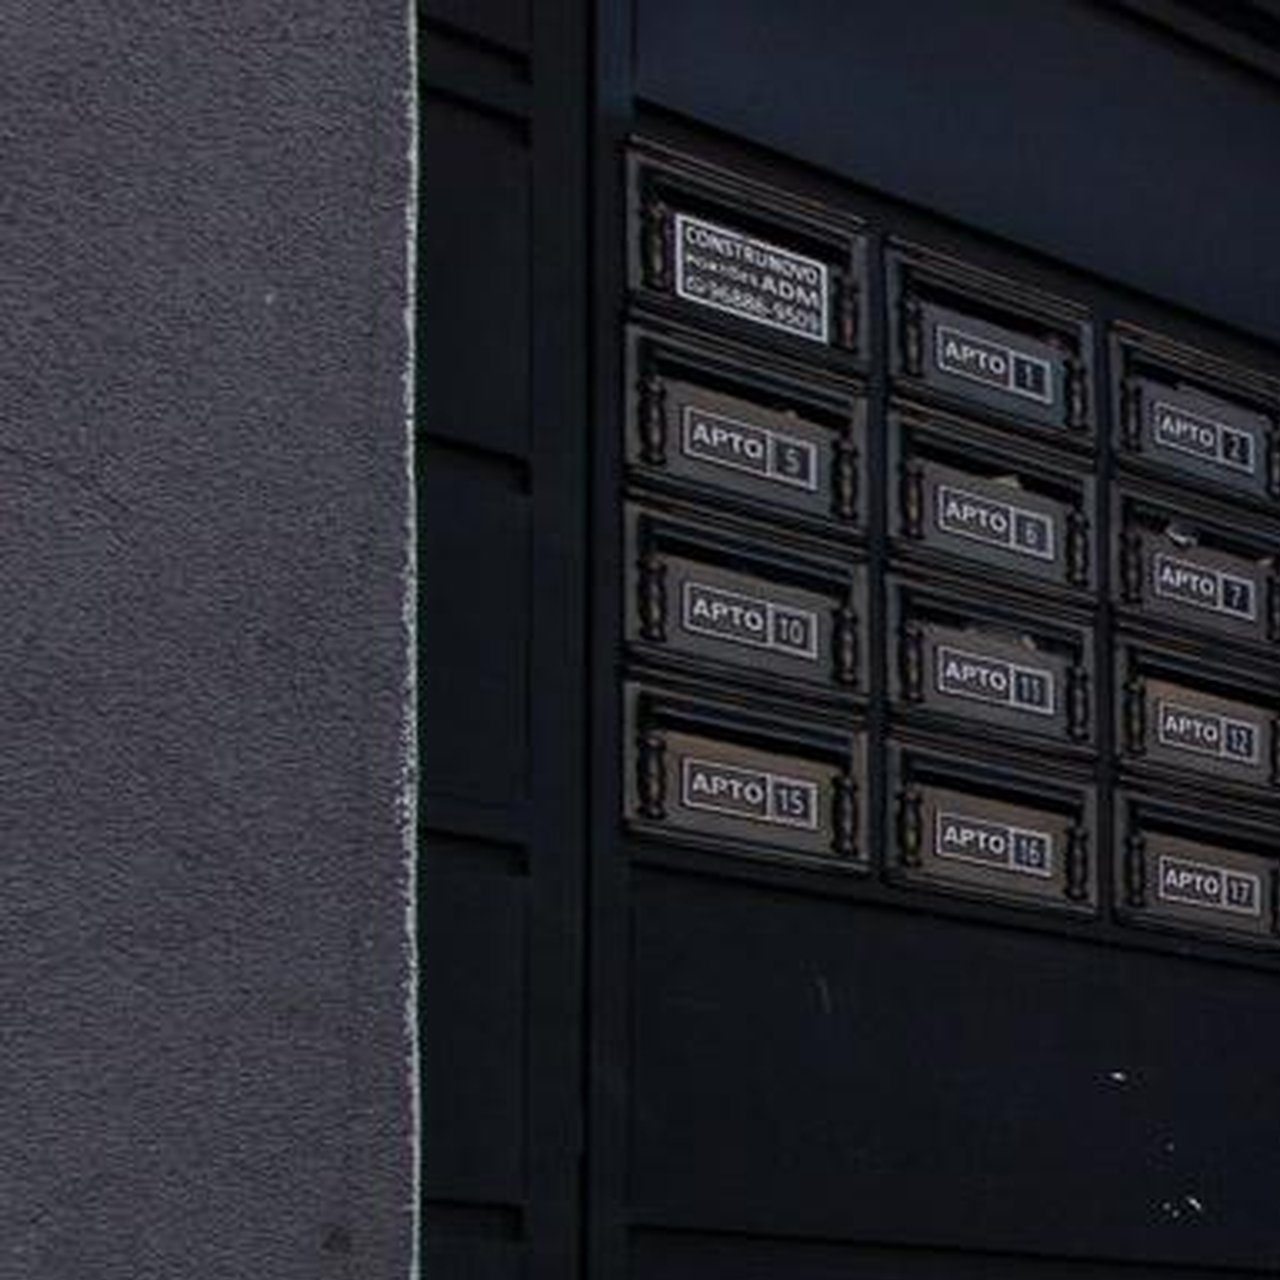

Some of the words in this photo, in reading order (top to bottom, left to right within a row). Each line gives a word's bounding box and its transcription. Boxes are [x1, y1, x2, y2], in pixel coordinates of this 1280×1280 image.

[761, 276, 818, 308] ADM
[944, 340, 1007, 376] APTO
[1022, 360, 1035, 388] 1
[692, 423, 764, 460] APTO
[783, 451, 800, 477] 5
[1160, 414, 1216, 449] APTO
[1229, 434, 1244, 459] 2
[944, 500, 1008, 533] APTO
[1024, 521, 1039, 546] 6
[1160, 563, 1216, 596] APTO
[1229, 583, 1244, 606] 7
[692, 595, 765, 631] APTO
[779, 616, 803, 645] 10
[944, 659, 1008, 692] APTO
[1020, 676, 1043, 702] 11
[1164, 714, 1218, 745] APTO
[1227, 728, 1250, 756] 12
[692, 772, 764, 805] APTO
[779, 786, 803, 815] 15
[943, 823, 1007, 855] APTO
[1019, 838, 1043, 866] 16
[1164, 867, 1219, 897] APTO
[1228, 877, 1251, 903] 17
